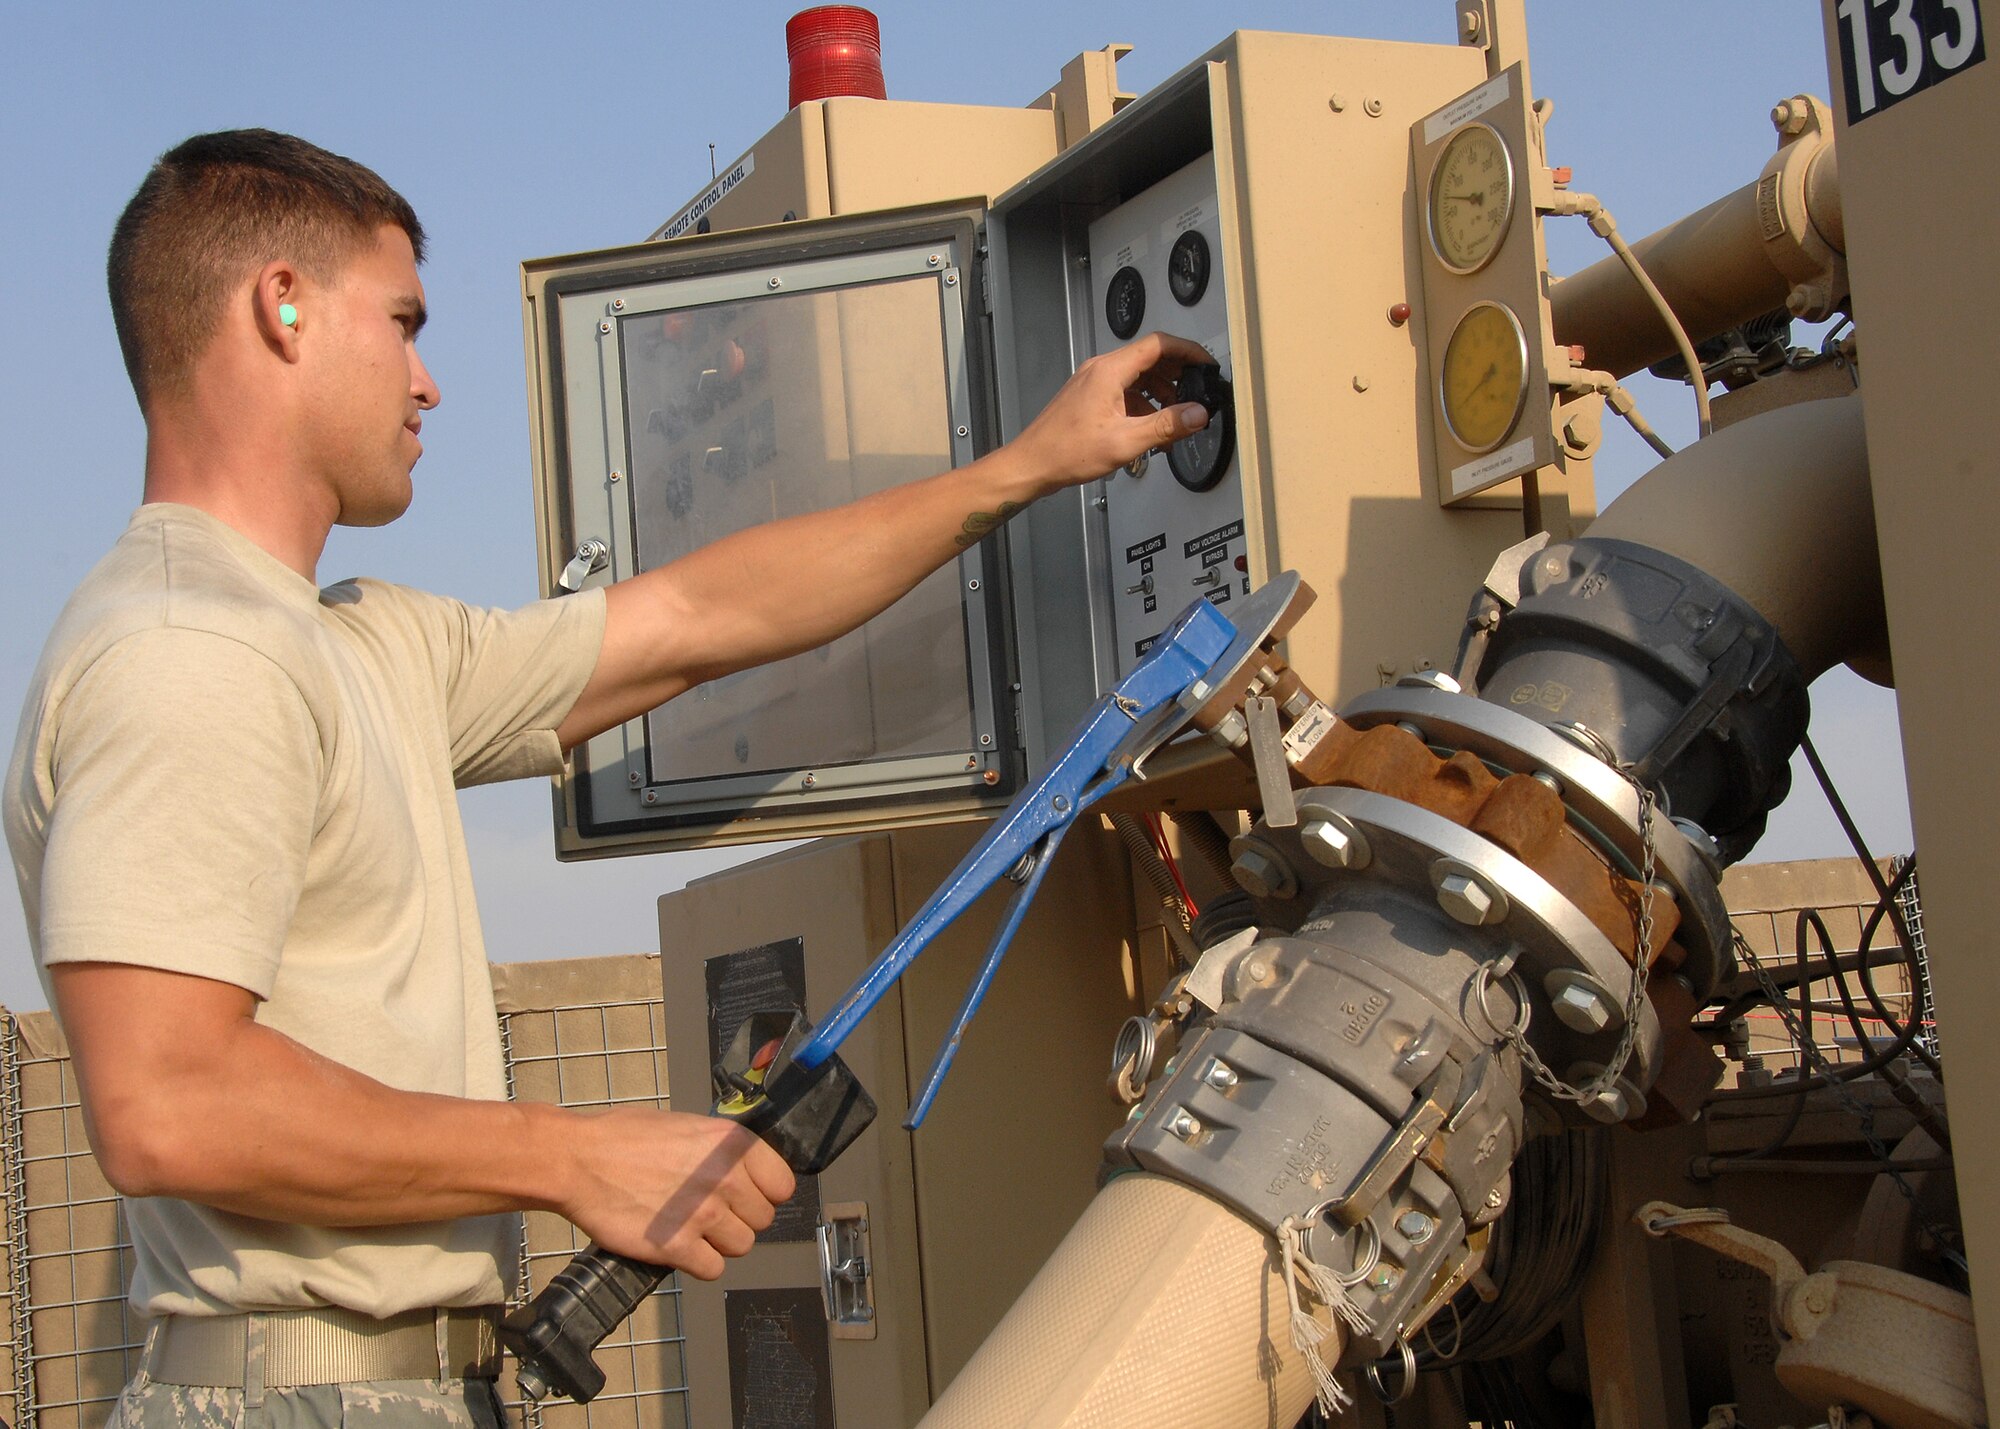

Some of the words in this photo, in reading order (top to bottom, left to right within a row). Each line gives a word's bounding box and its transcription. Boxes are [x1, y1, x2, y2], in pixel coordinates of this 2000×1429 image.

[664, 213, 689, 240] REMOTE
[690, 186, 721, 221] CONTROL
[722, 165, 746, 195] PANEL
[1130, 545, 1145, 557] PANEL
[1145, 539, 1161, 552] LIGHTS
[1189, 541, 1200, 552] LOW
[1200, 532, 1221, 549] VOLTAGE
[1221, 525, 1239, 538] ALARM
[1205, 549, 1224, 563] BYPASS
[1143, 561, 1151, 571] ON
[1145, 599, 1155, 609] OFF
[1288, 707, 1317, 739] PREFERRED
[1307, 727, 1325, 747] FLOW
